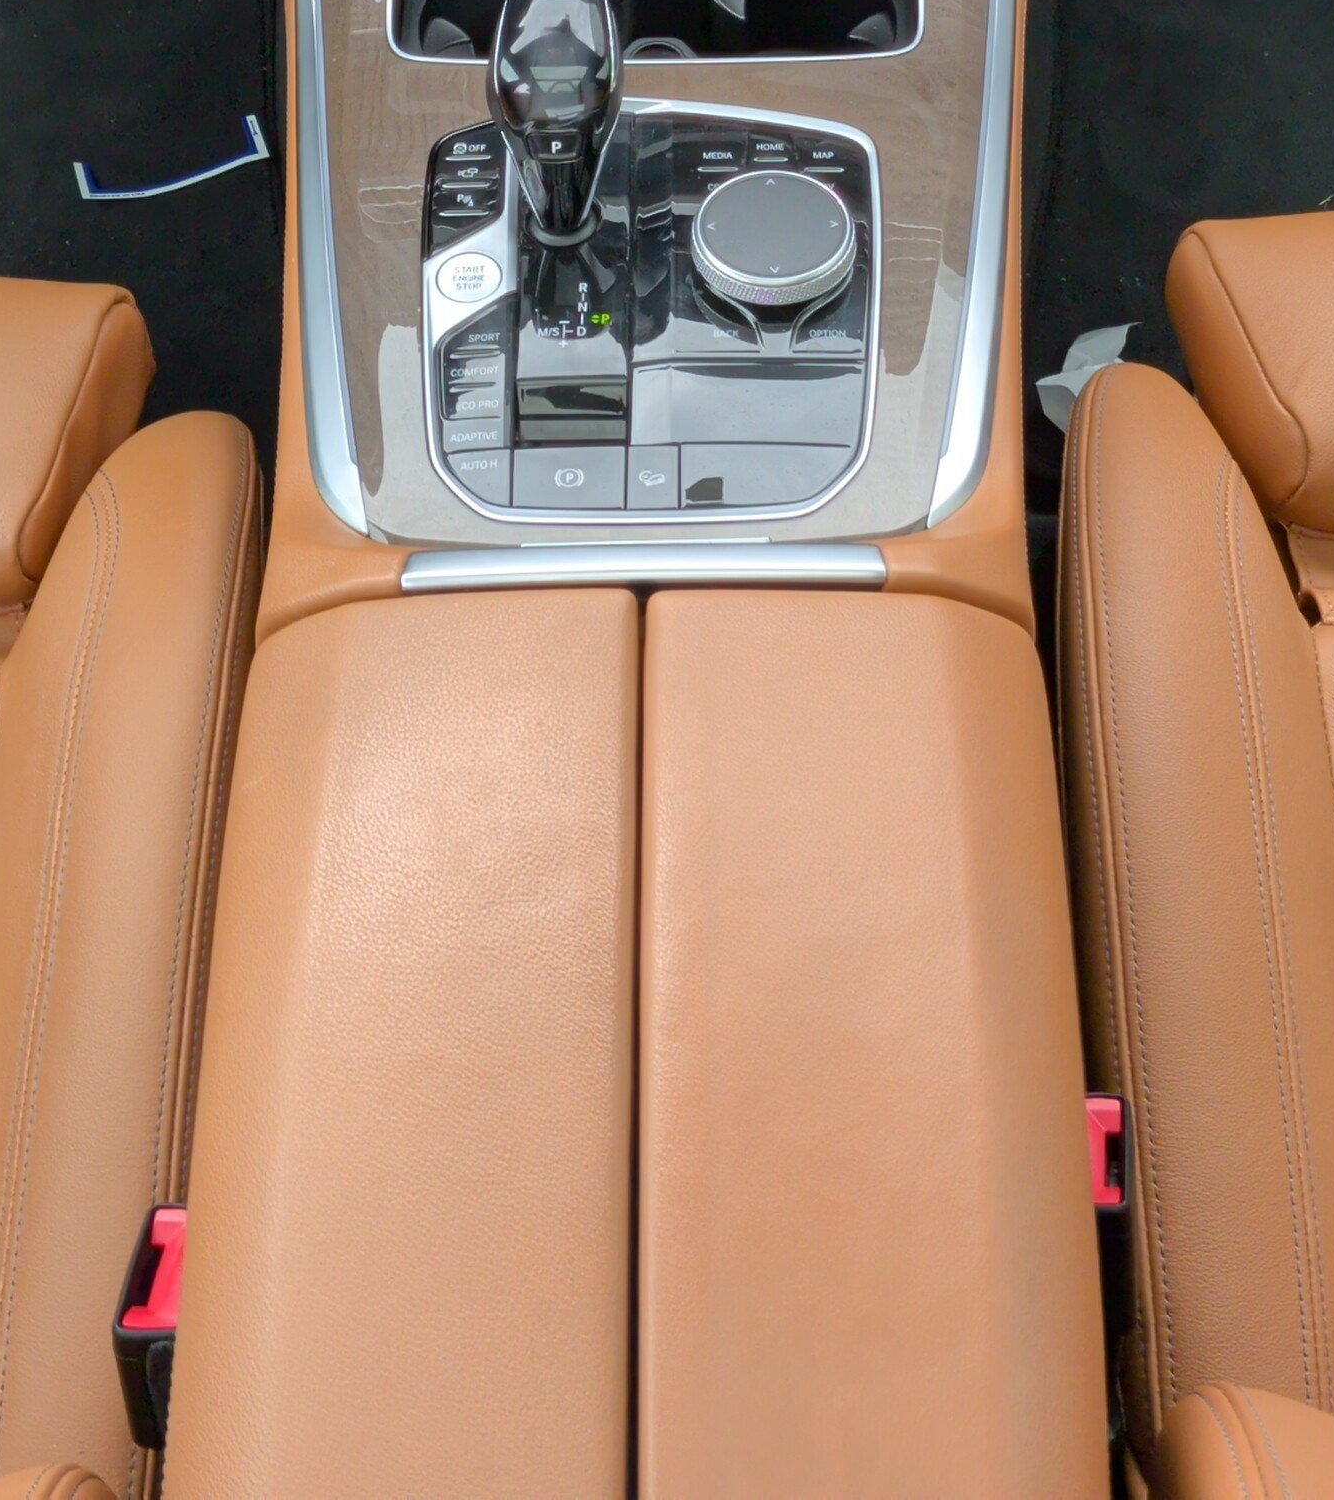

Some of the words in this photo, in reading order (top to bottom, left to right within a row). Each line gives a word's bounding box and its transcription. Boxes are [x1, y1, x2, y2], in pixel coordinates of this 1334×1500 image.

[467, 143, 487, 153] OFF
[550, 140, 563, 155] P
[756, 142, 785, 151] HOME
[702, 151, 733, 161] MEDIA
[812, 151, 835, 160] MAP
[454, 265, 485, 274] START
[452, 274, 485, 282] ENGINE
[455, 282, 483, 291] STOP
[578, 282, 588, 293] R
[578, 301, 588, 312] N
[601, 313, 612, 325] P
[537, 326, 560, 338] M/S
[576, 326, 587, 337] D
[713, 329, 740, 339] BACK
[809, 328, 847, 339] OPTION
[468, 332, 501, 344] SPORT
[450, 366, 500, 378] COMFORT
[455, 400, 476, 412] ECO
[478, 399, 500, 410] PRO
[450, 430, 499, 443] ADAPTIVE
[460, 459, 488, 471] AUTO
[489, 459, 498, 469] H
